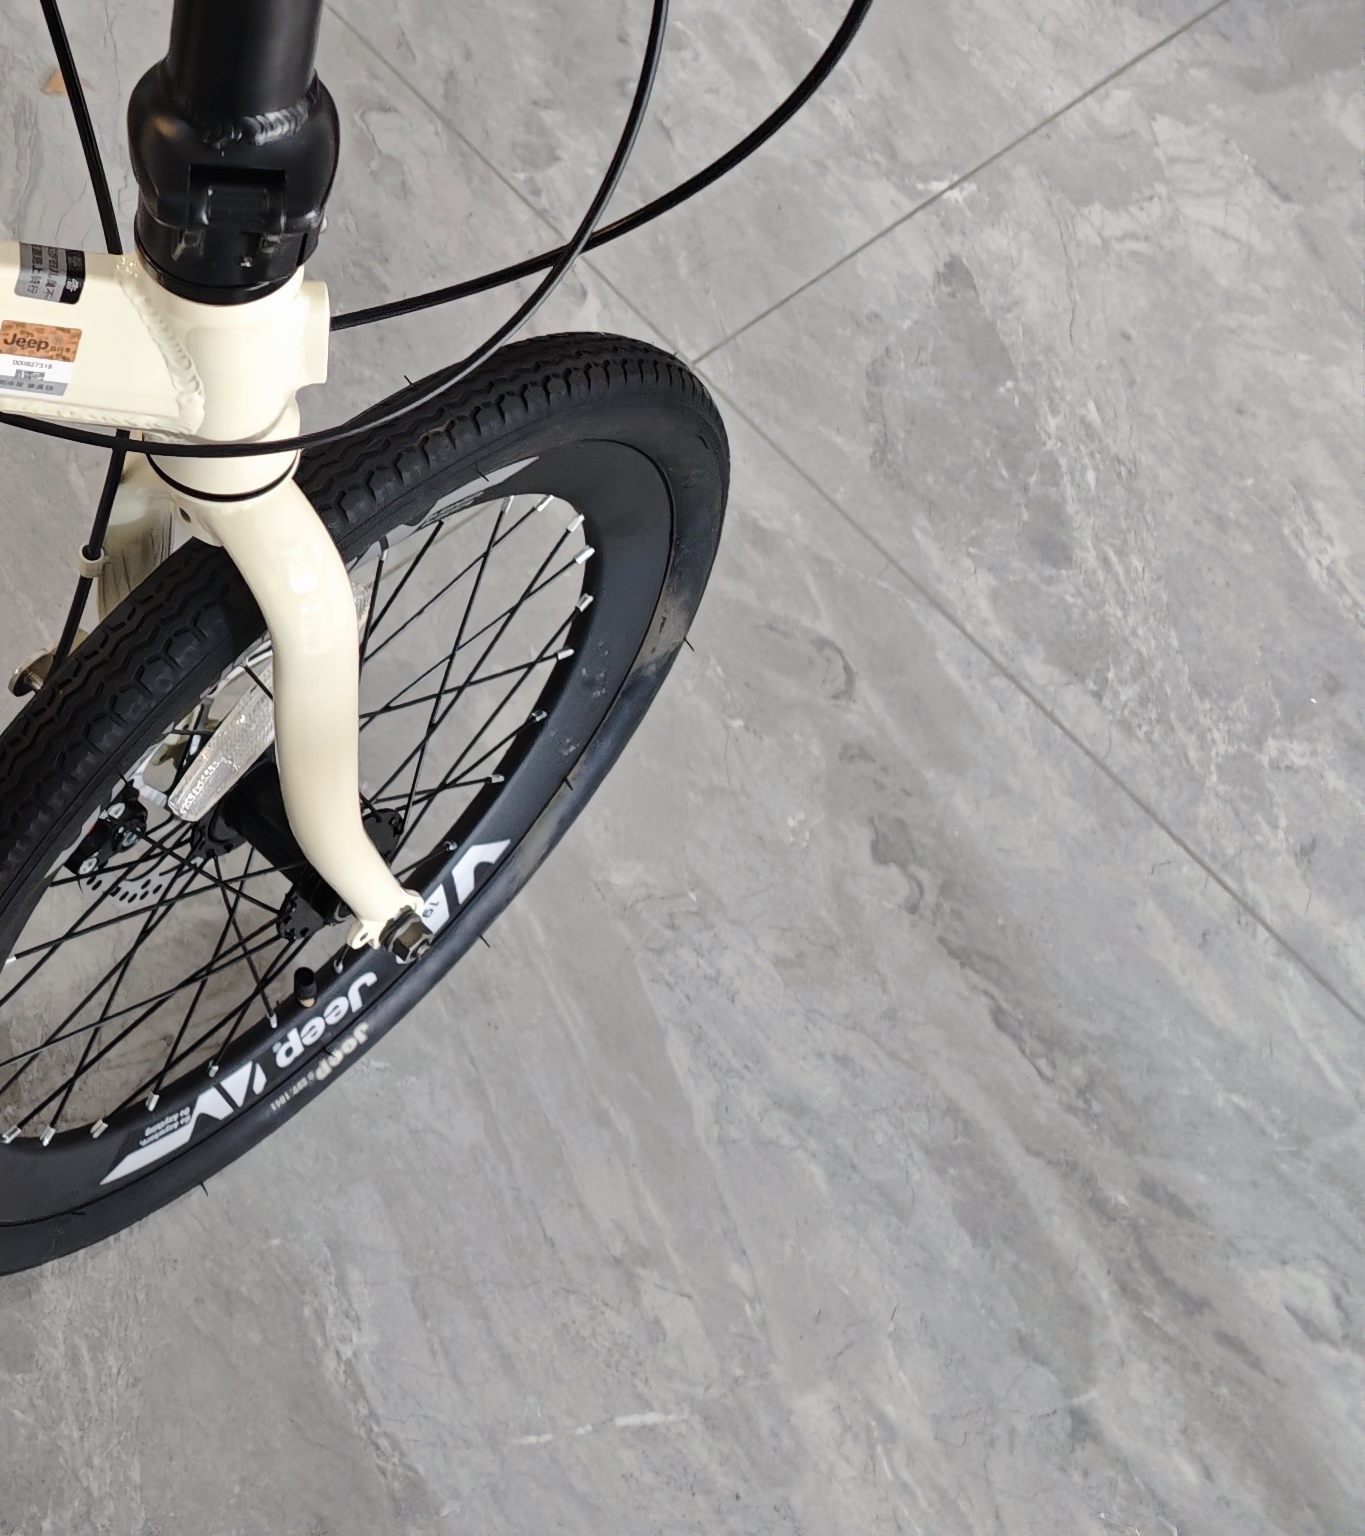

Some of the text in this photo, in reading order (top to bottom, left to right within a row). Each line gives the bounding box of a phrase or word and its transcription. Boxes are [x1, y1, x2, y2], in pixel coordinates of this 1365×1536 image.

[3, 332, 50, 353] Jeep
[276, 971, 378, 1069] Jeep
[315, 1021, 370, 1081] Jeep
